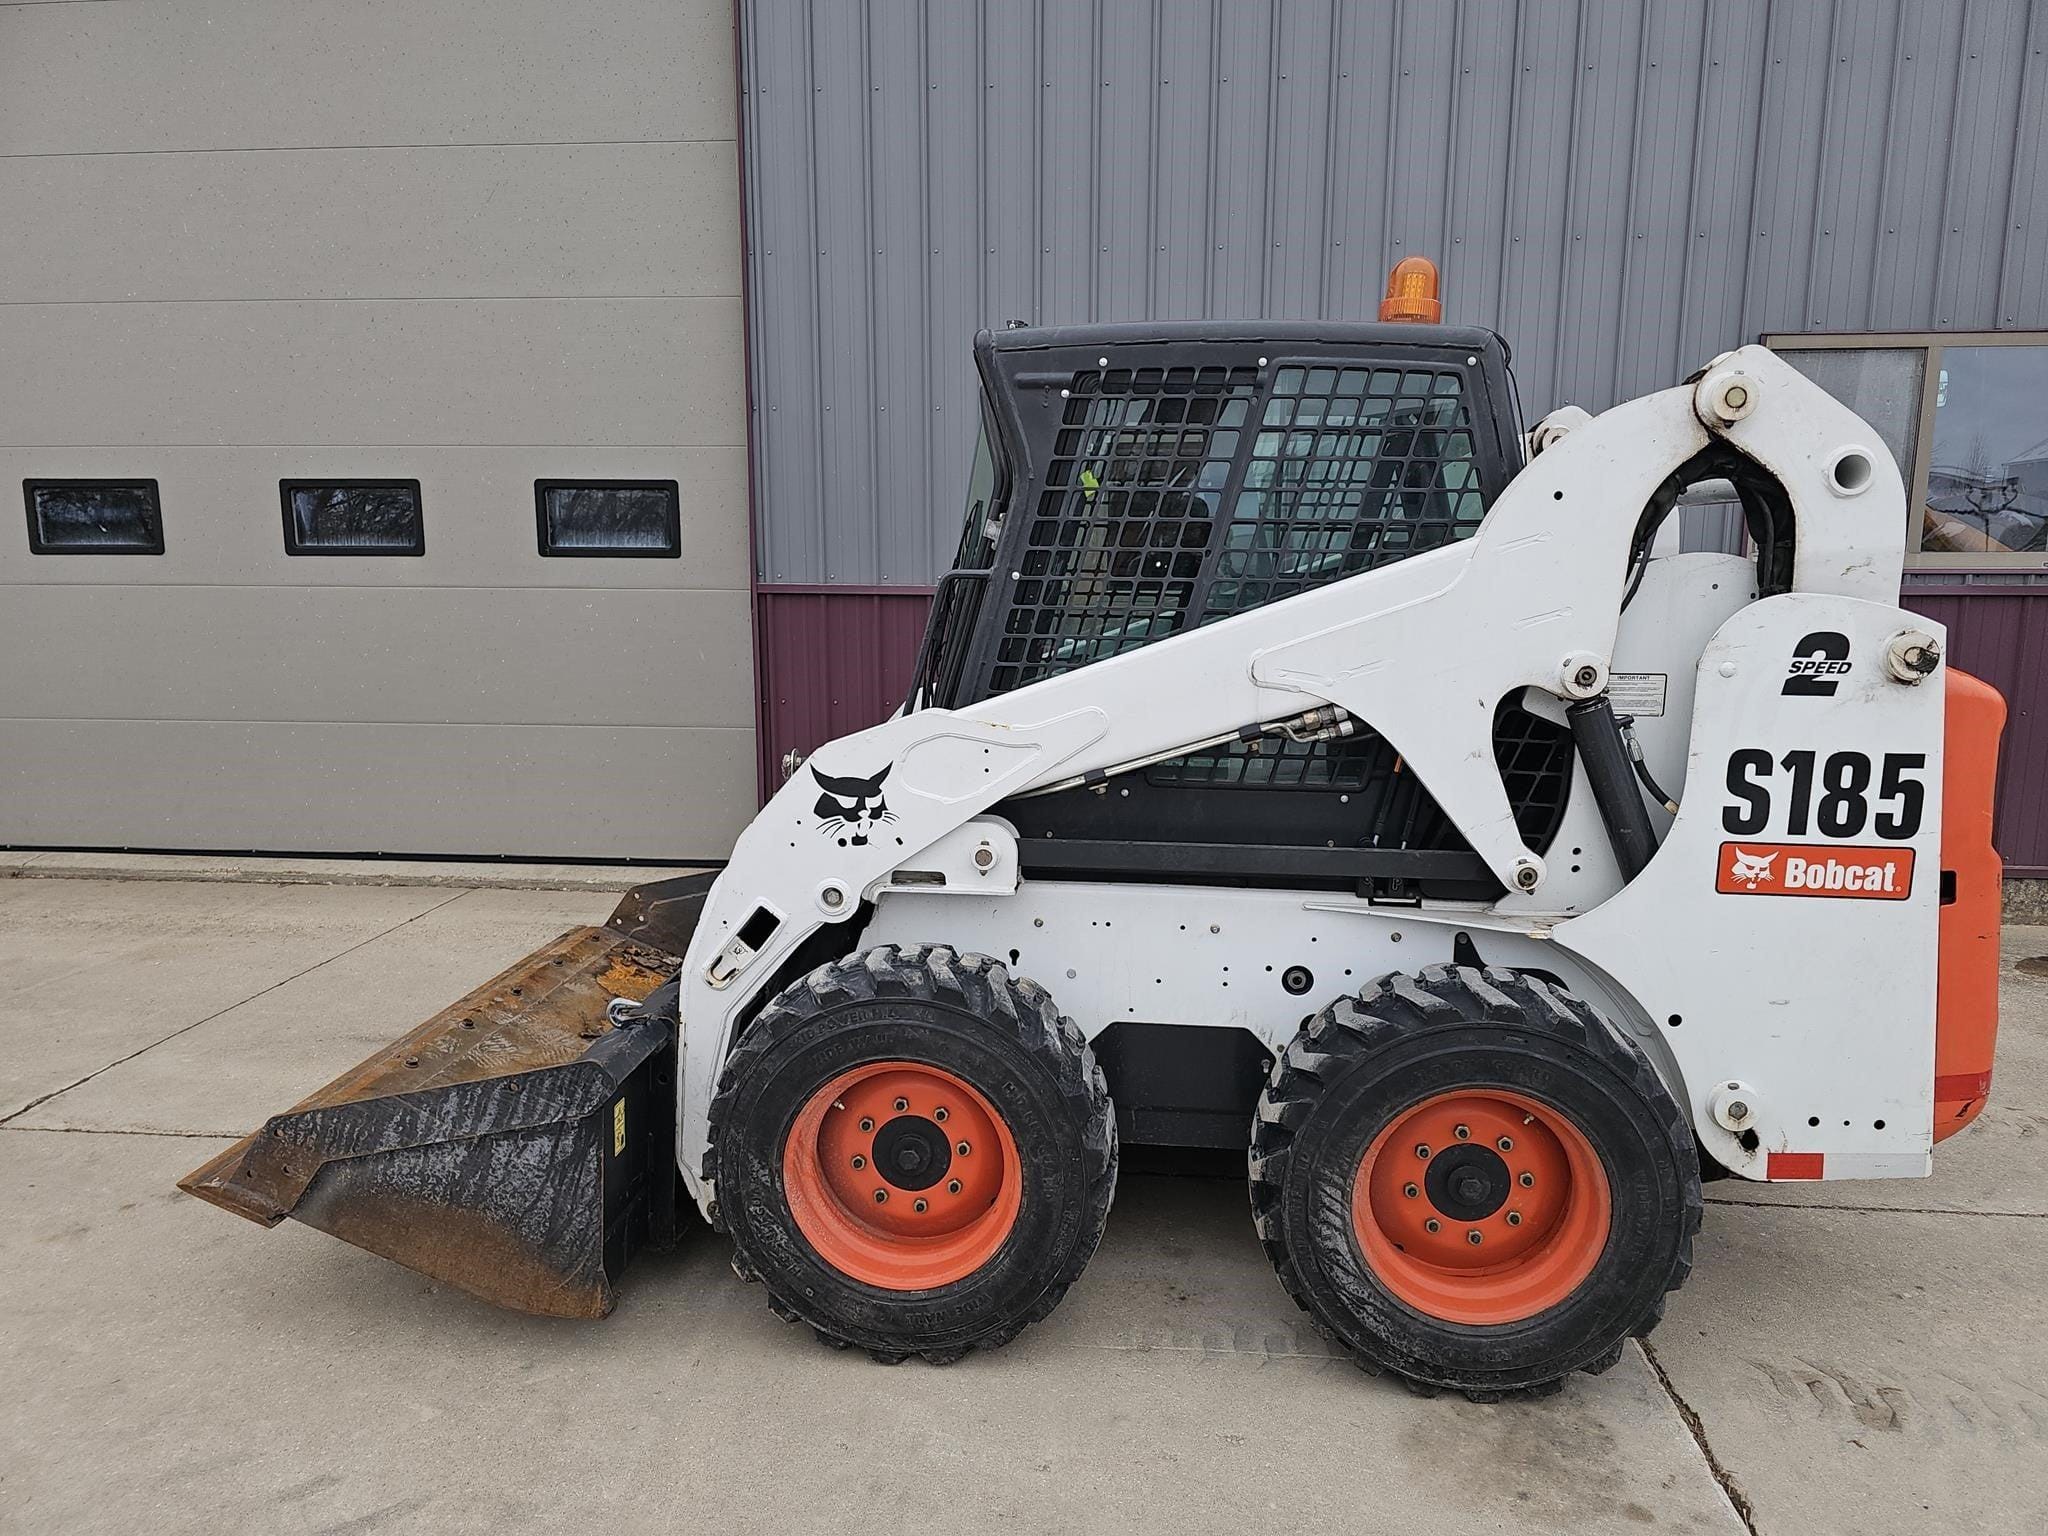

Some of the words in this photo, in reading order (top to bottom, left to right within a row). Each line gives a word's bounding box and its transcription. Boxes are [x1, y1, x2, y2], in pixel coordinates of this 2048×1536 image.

[1781, 631, 1851, 696] 2
[1788, 661, 1852, 675] SPEED
[1722, 748, 1926, 840] S185
[1784, 857, 1897, 893] Bobcat
